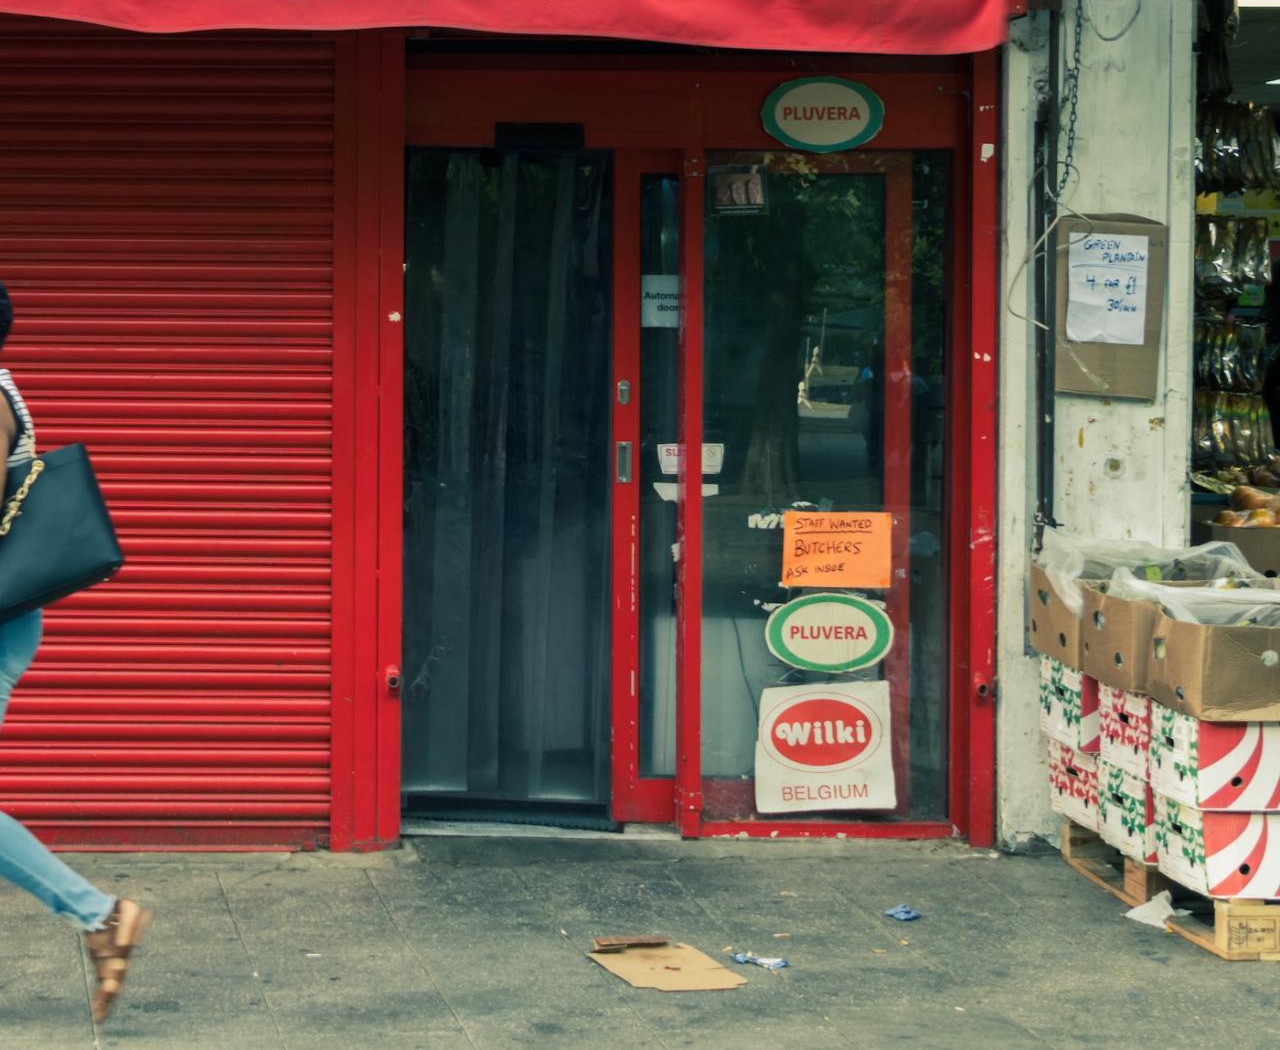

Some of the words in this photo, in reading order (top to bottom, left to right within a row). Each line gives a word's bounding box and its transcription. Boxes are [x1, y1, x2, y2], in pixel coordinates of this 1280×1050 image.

[782, 106, 861, 122] PLUVERA
[1083, 238, 1122, 251] GREEN
[1085, 273, 1096, 292] 4
[1125, 275, 1137, 295] £1
[793, 517, 825, 530] STAFF
[829, 517, 872, 530] WANTED
[794, 538, 863, 557] BUTCHERS
[786, 564, 809, 580] ASK
[814, 562, 846, 573] INSIDE
[789, 625, 868, 641] PLUVERA
[775, 719, 867, 747] Wilki
[781, 783, 869, 802] BELGIUM
